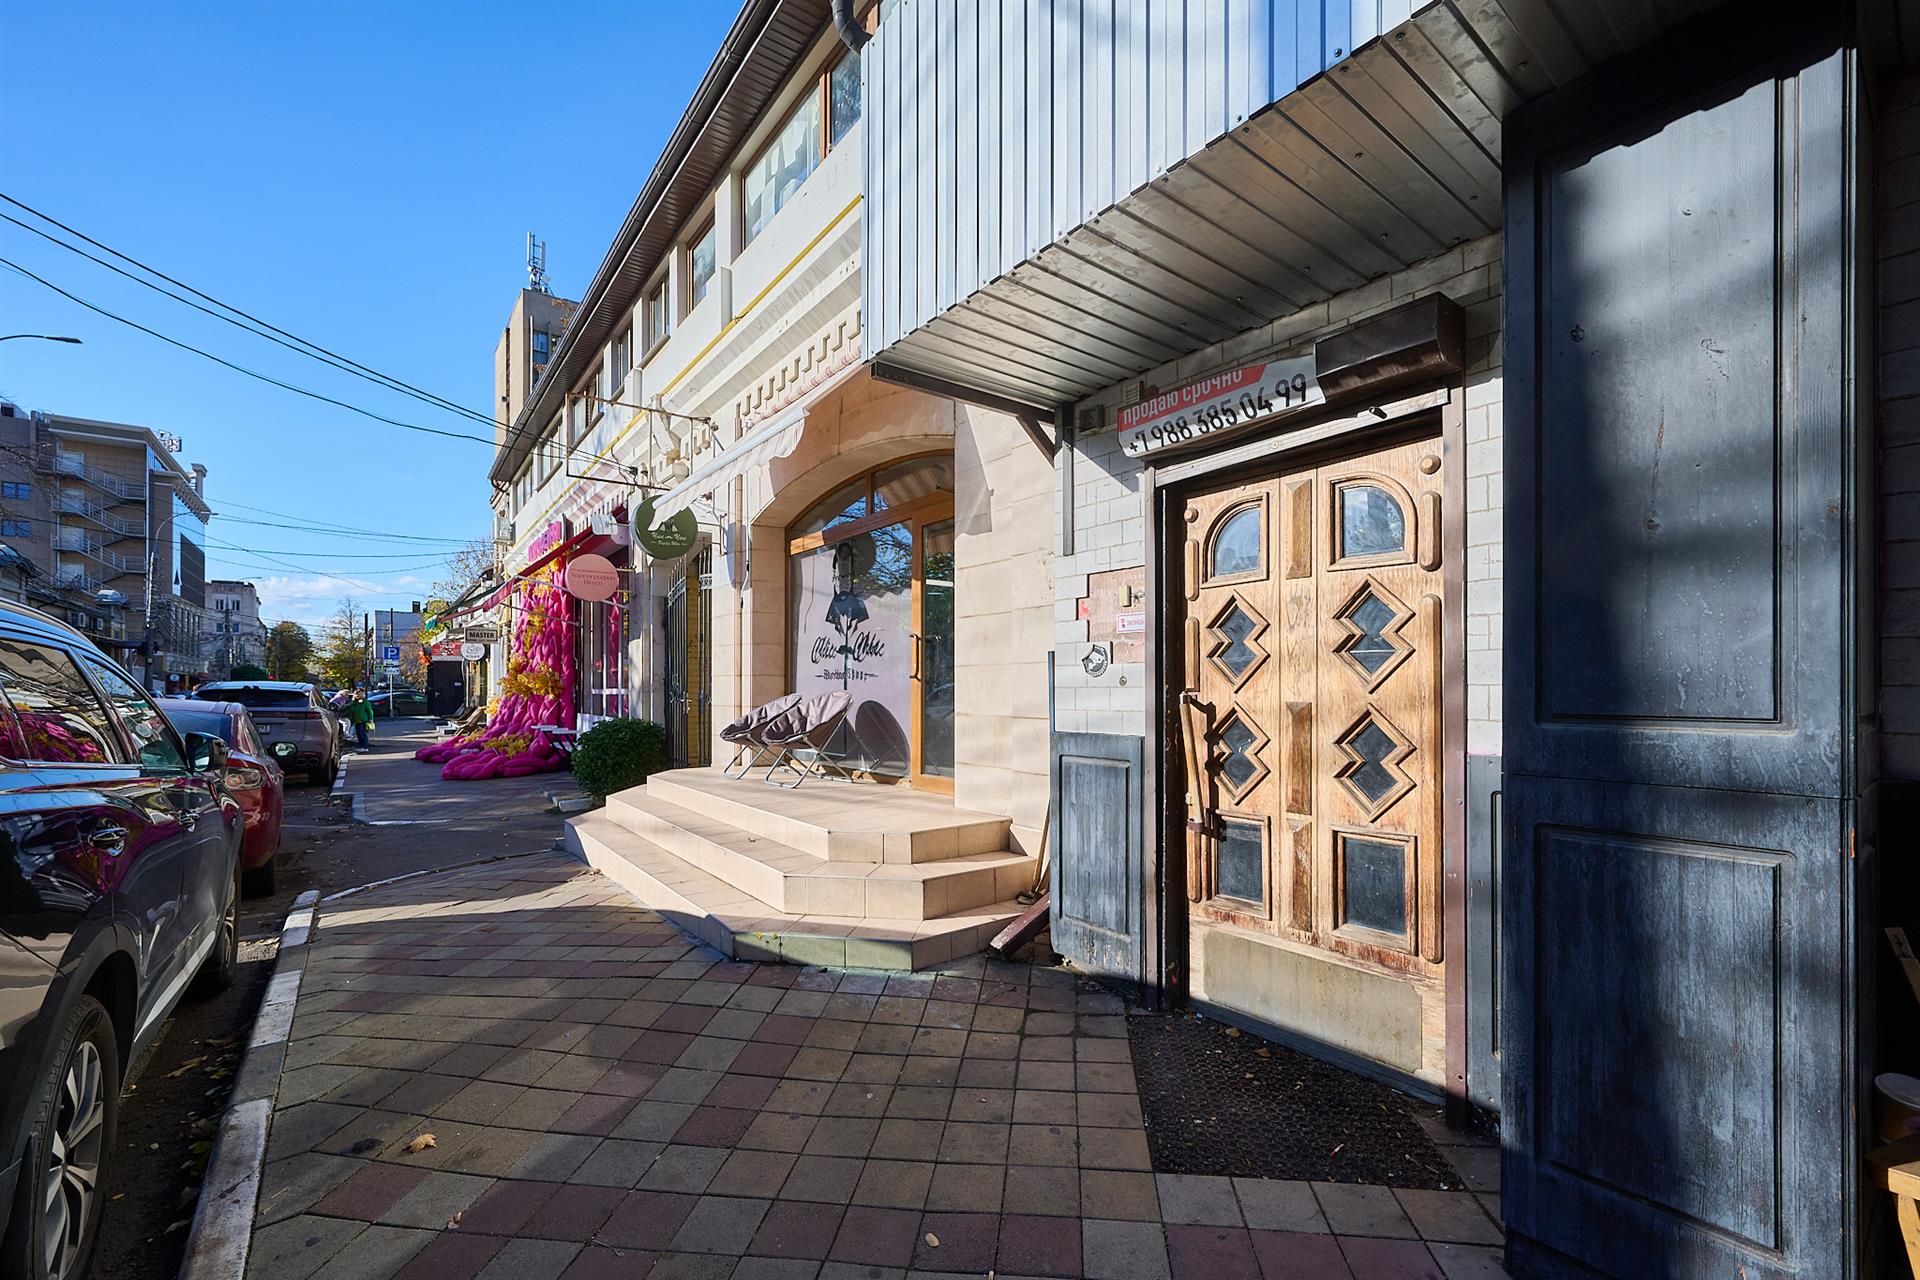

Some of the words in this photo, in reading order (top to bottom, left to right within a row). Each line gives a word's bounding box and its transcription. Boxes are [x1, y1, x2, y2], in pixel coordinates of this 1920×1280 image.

[1123, 392, 1179, 426] продаю
[1182, 368, 1243, 403] срочно
[1129, 428, 1149, 452] +7
[1151, 415, 1193, 448] 988
[1193, 399, 1238, 433] 385
[1239, 386, 1273, 419] 04
[1275, 373, 1307, 408] 99
[469, 631, 495, 639] MASTER
[387, 647, 398, 659] P
